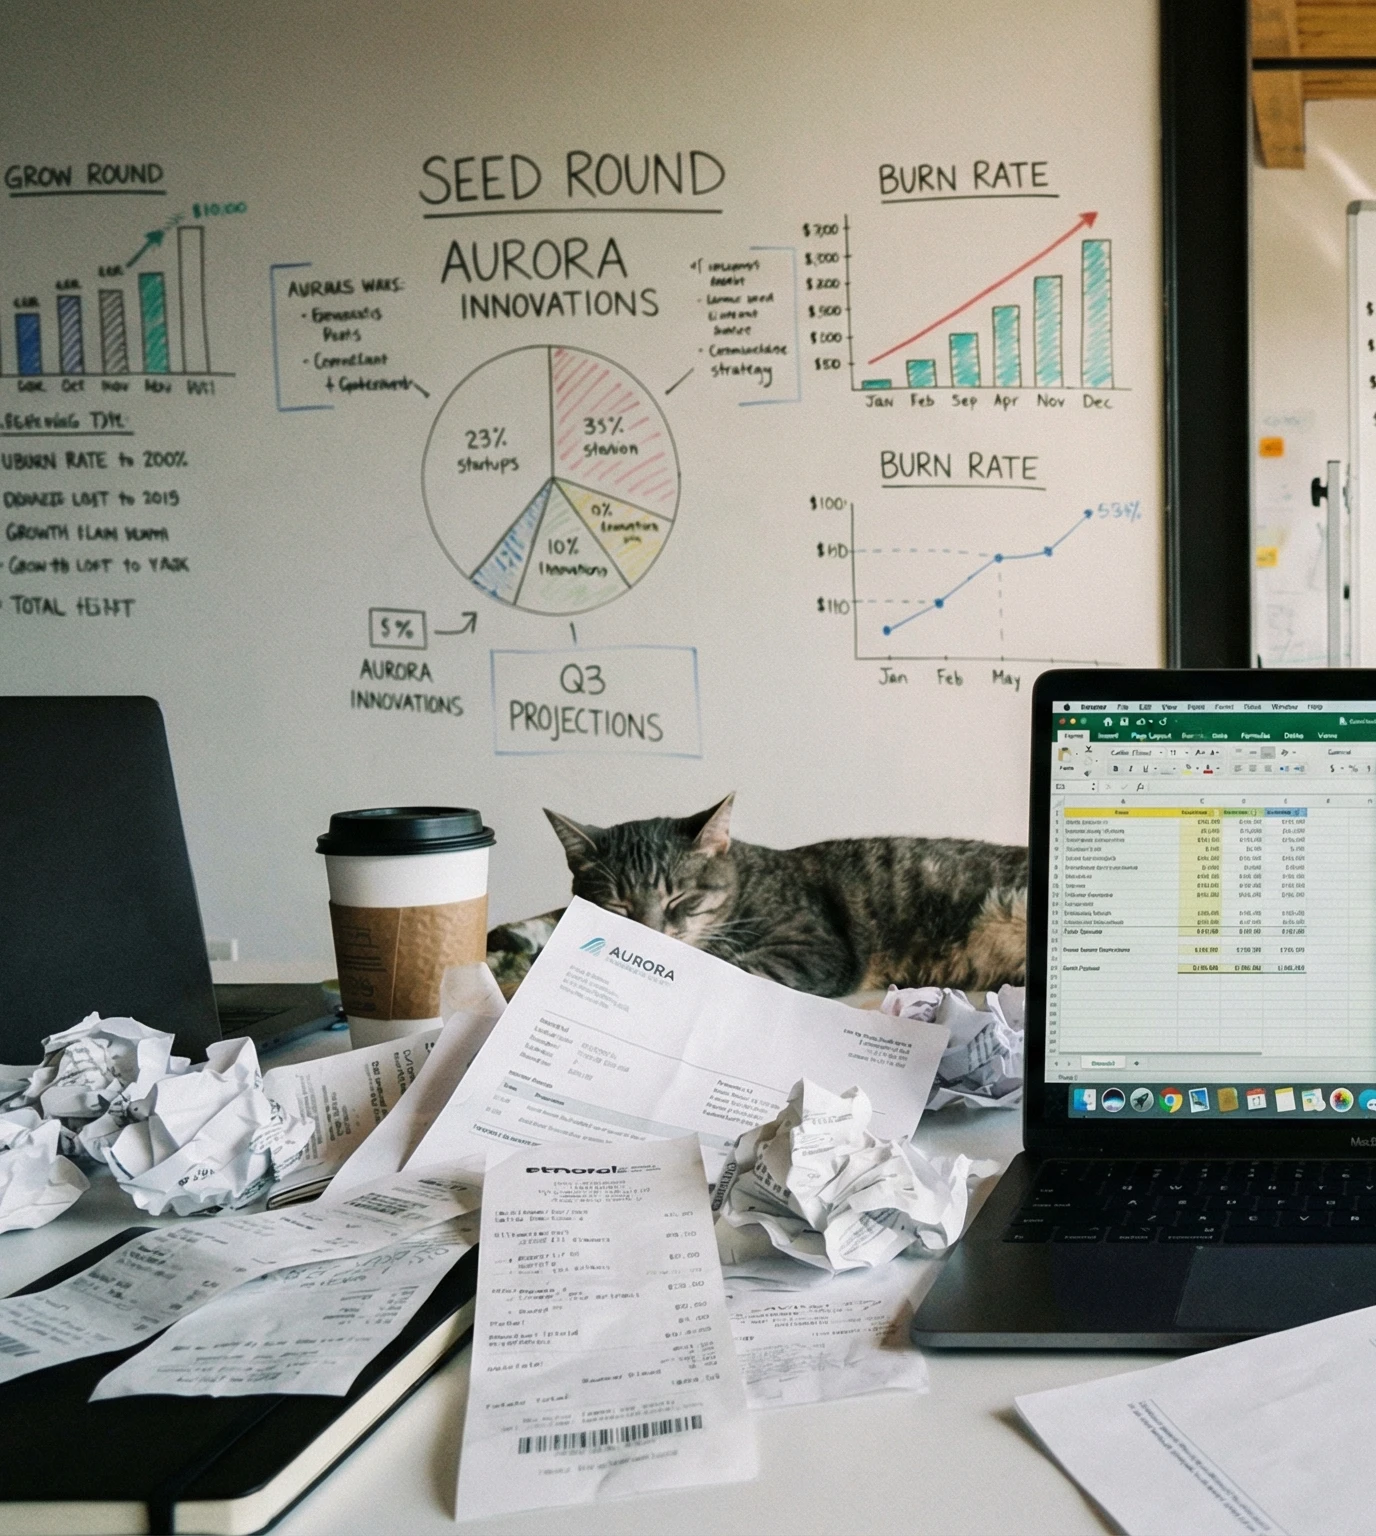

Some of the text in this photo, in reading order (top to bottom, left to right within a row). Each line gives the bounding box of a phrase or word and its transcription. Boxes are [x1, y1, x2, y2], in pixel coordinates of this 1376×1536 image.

[5, 163, 163, 189] GROW ROUND
[419, 150, 726, 205] SEED ROUND
[879, 160, 1048, 195] BURN RATE
[441, 236, 627, 284] AURORA
[461, 288, 660, 320] INNOVATIONS
[865, 393, 1112, 412] Jan Feb Sep Apr Nov Dec
[465, 427, 507, 449] 23%
[66, 451, 107, 470] RATE
[119, 452, 134, 467] to
[143, 451, 188, 468] 200%
[458, 457, 519, 474] startups
[880, 450, 1039, 480] BURN RATE
[119, 491, 135, 507] to
[548, 536, 579, 556] 10%
[123, 558, 141, 573] to
[9, 595, 66, 616] TOTAL
[360, 658, 434, 683] AURORA
[560, 664, 605, 695] Q3
[878, 667, 1020, 692] Jan Feb May
[350, 690, 464, 716] INNOVATIONS
[510, 700, 664, 742] PROJECTIONS
[608, 945, 676, 983] AURORA
